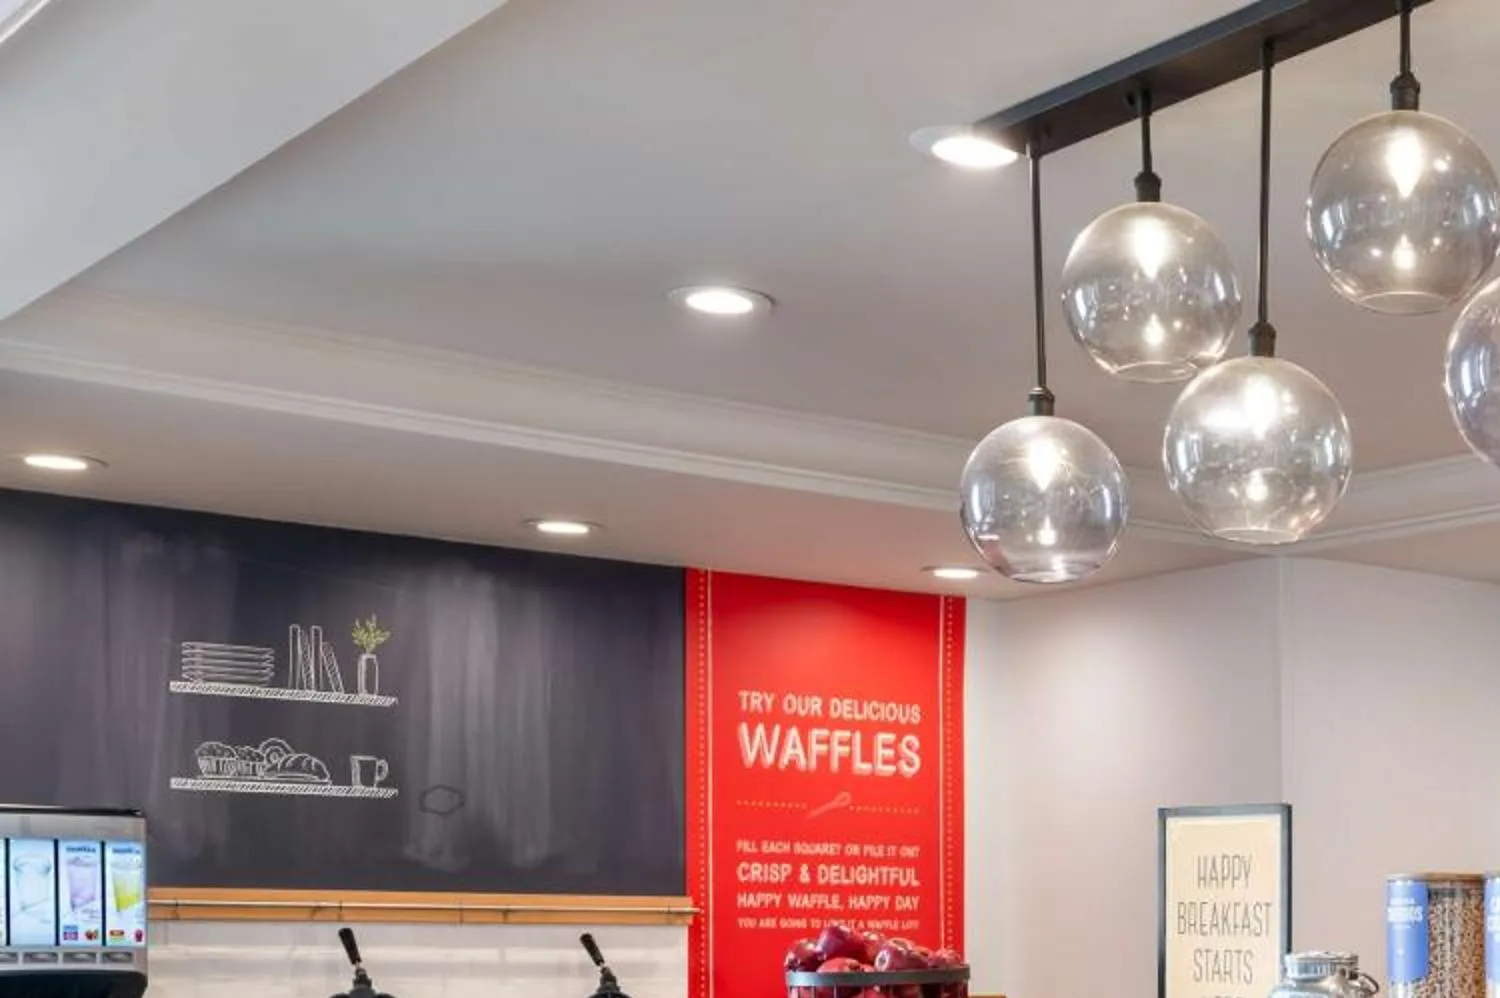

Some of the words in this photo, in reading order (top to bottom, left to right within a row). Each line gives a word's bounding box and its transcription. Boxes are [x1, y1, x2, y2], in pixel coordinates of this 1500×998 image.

[738, 690, 775, 713] TRY
[783, 692, 823, 717] OUR
[829, 697, 922, 725] DELICIOUS
[737, 721, 921, 778] WAFFLES
[762, 840, 790, 853] EACH
[846, 843, 860, 856] OR
[736, 861, 792, 884] CRISP
[800, 863, 811, 884] &
[818, 864, 920, 886] DELIGHTFUL
[1197, 854, 1252, 888] HAPPY
[736, 892, 782, 908] HAPPY
[788, 893, 844, 910] WAFFLE,
[848, 894, 891, 909] HAPPY
[895, 895, 920, 911] DAY
[1176, 901, 1272, 937] BREAKFAST
[1193, 948, 1254, 984] STARTS
